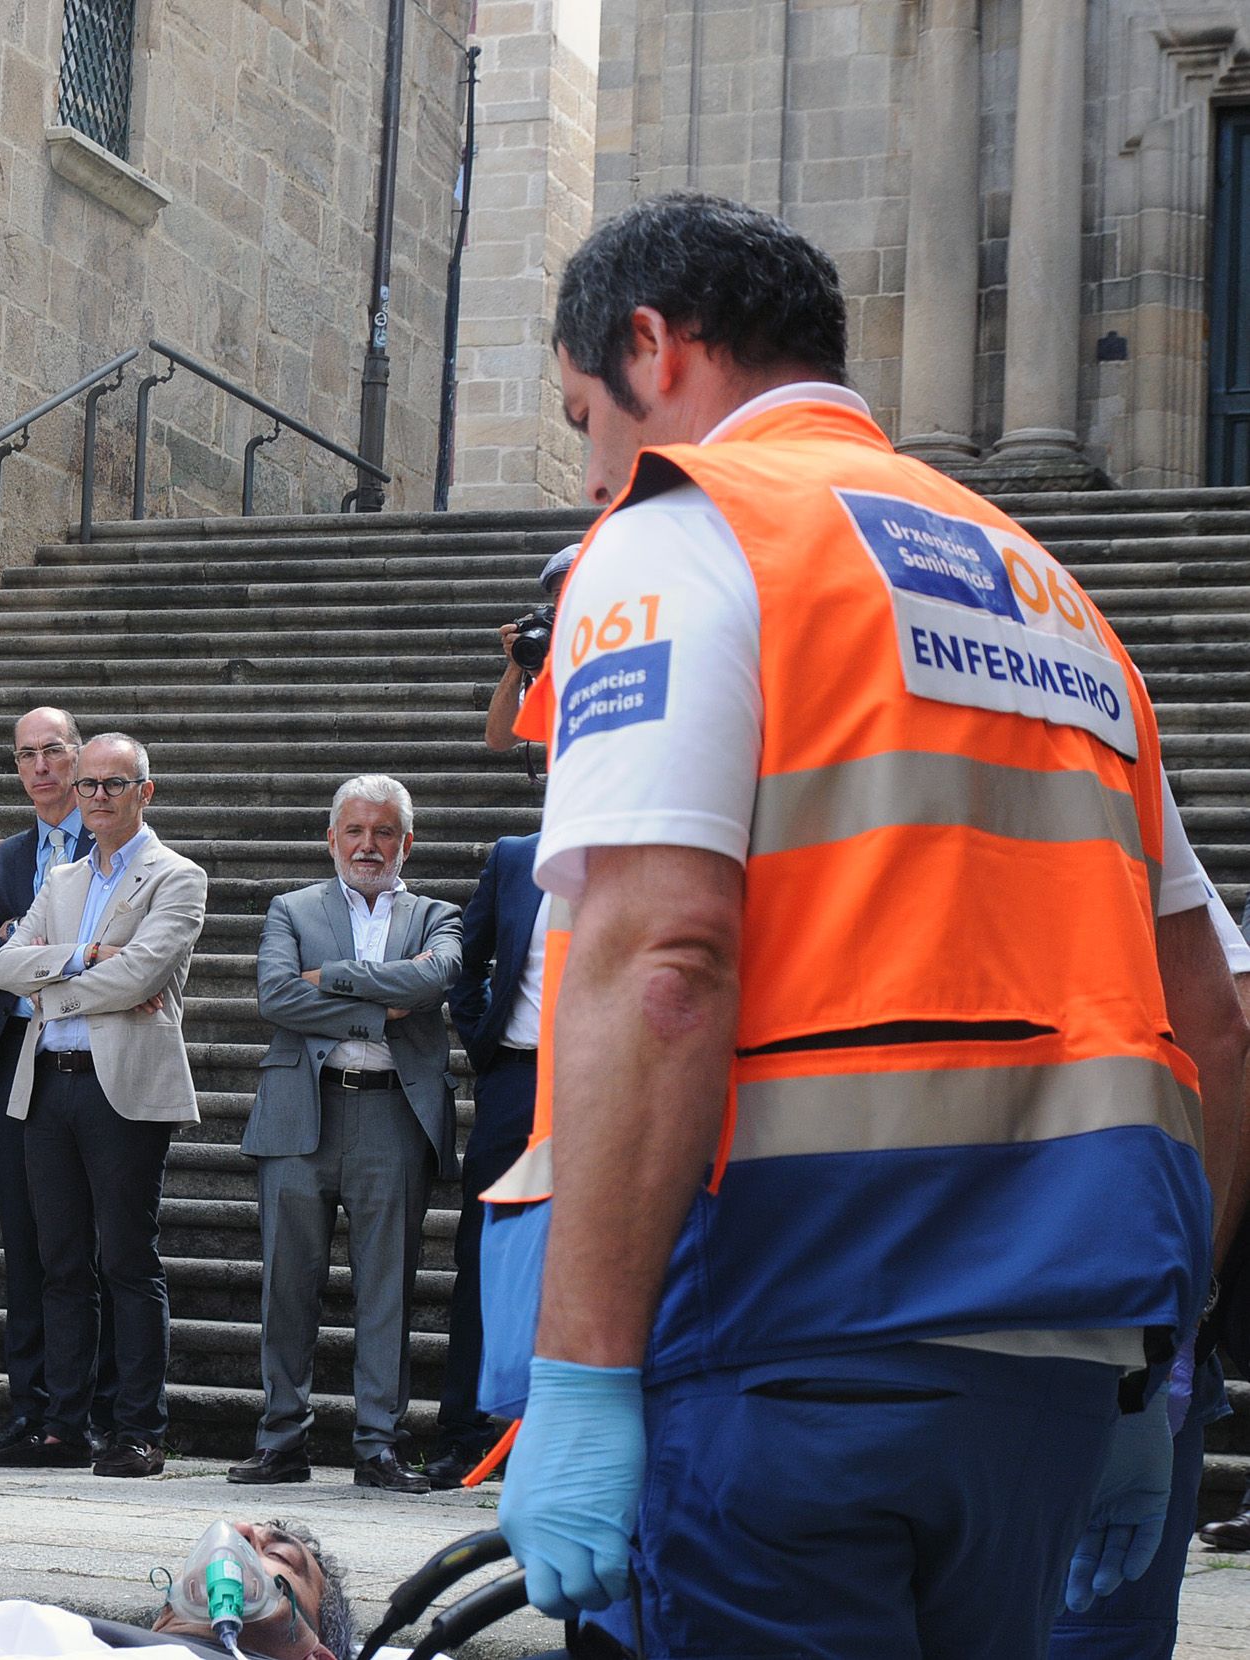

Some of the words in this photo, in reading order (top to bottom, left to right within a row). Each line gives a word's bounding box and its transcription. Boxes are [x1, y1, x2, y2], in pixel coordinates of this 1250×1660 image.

[882, 518, 981, 563] Urxencias
[897, 546, 995, 591] Sanitarias
[571, 594, 661, 668] 061
[911, 625, 1120, 721] ENFERMEIRO
